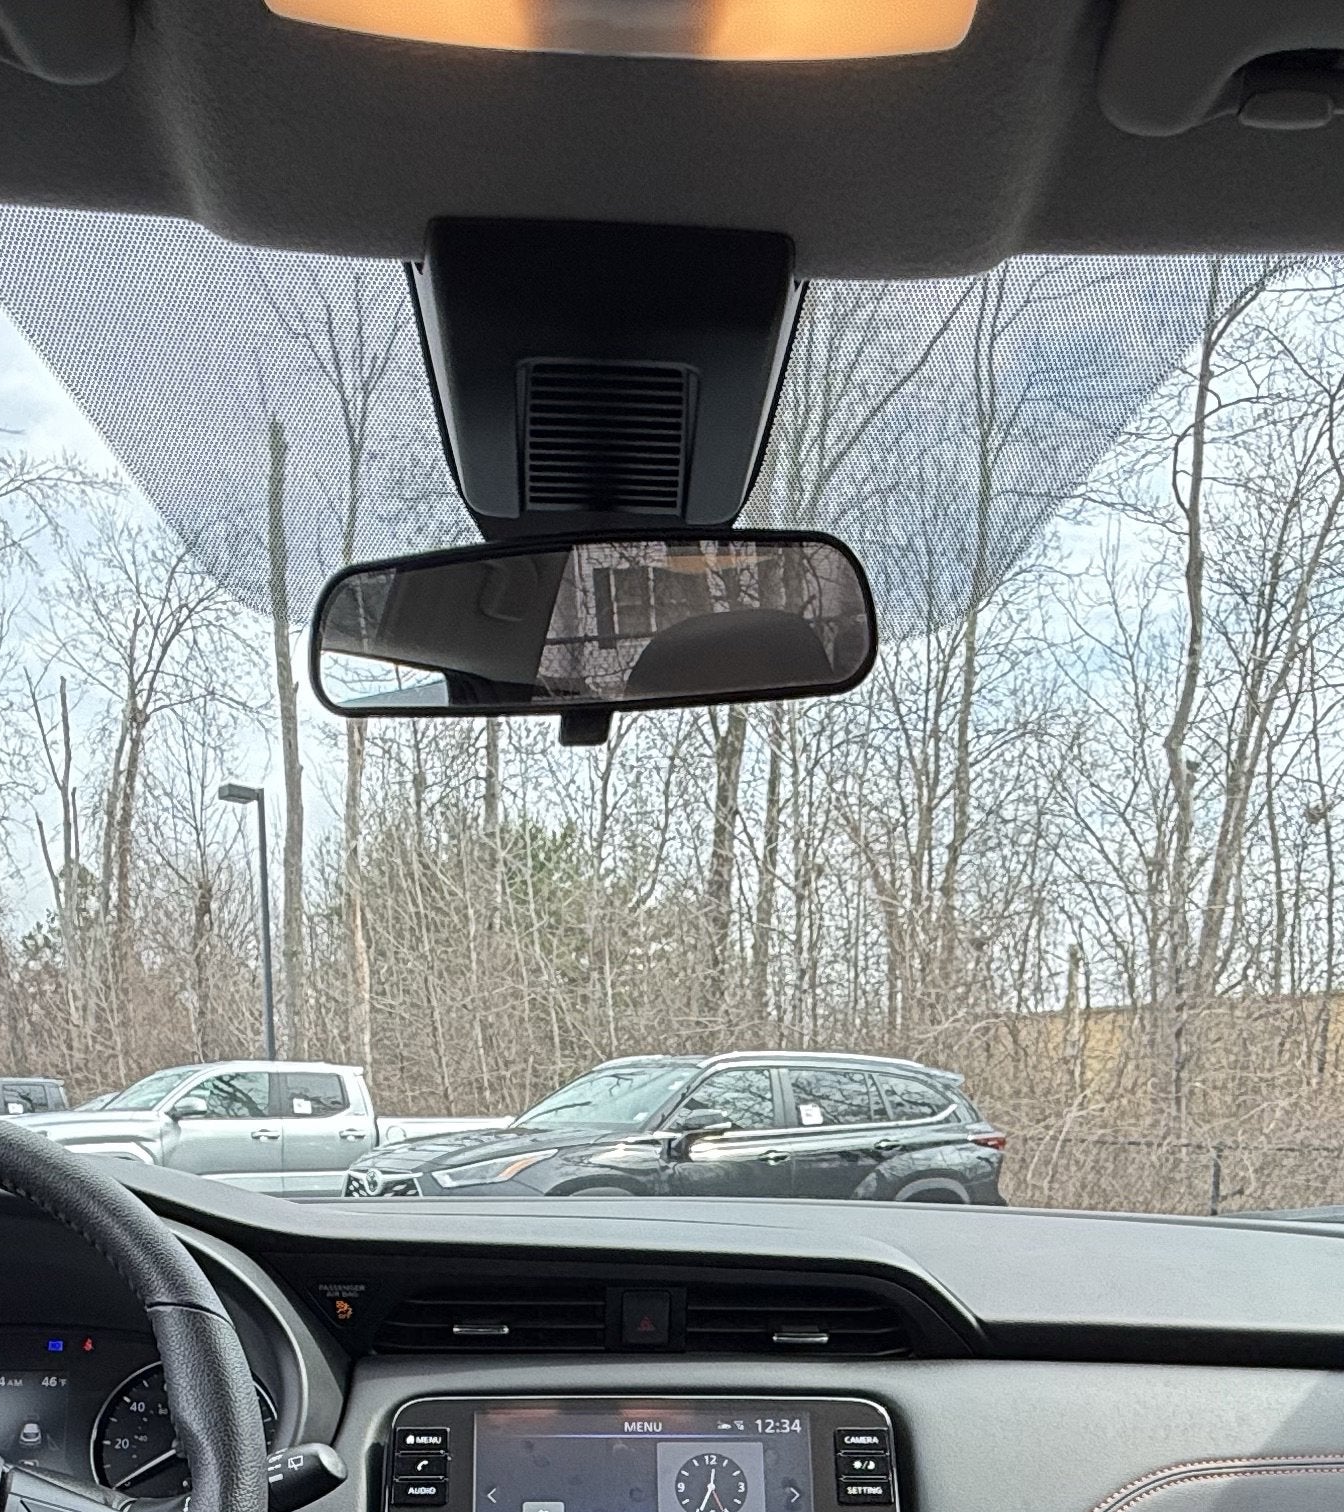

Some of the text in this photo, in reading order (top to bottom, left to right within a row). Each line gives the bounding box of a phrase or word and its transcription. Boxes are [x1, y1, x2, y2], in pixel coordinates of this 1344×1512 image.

[7, 1379, 23, 1387] AM
[129, 1401, 146, 1412] 40
[624, 1418, 802, 1434] MENU 12:34
[114, 1437, 130, 1449] 20
[415, 1436, 442, 1444] MENU
[844, 1435, 879, 1444] CAMERA
[704, 1455, 717, 1466] 12
[408, 1487, 437, 1495] AUDIO
[677, 1482, 745, 1493] 9 3
[846, 1486, 883, 1495] SETTING
